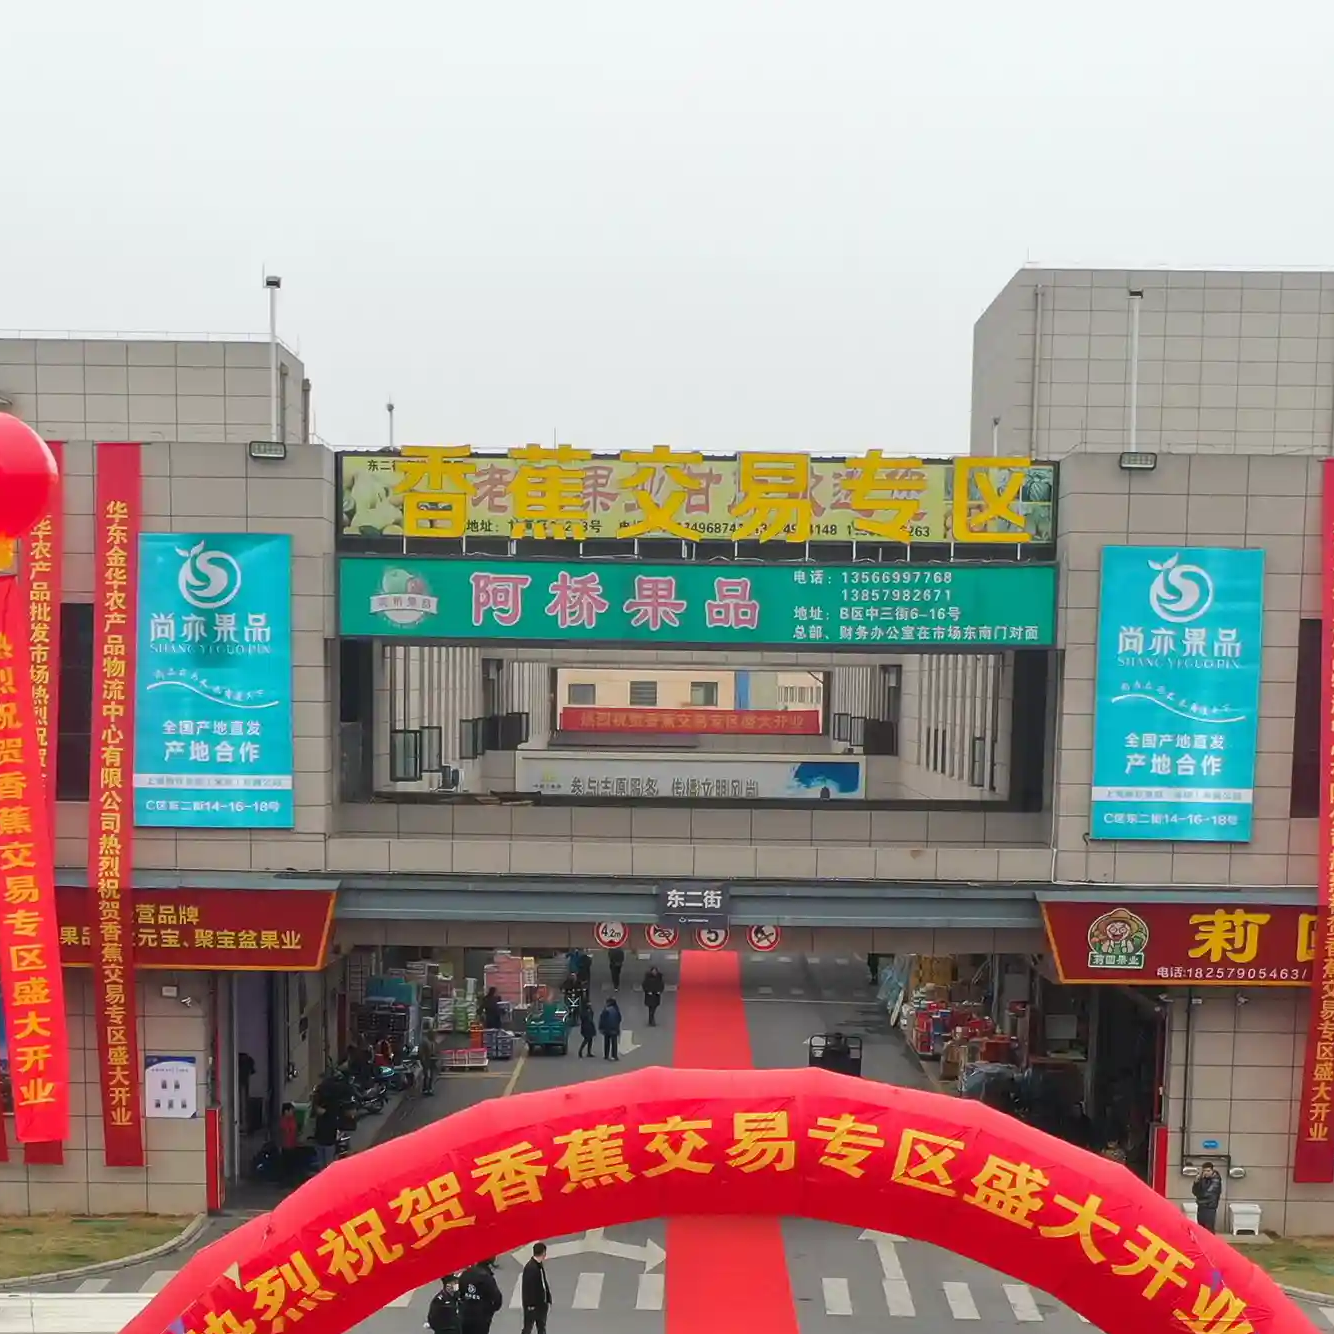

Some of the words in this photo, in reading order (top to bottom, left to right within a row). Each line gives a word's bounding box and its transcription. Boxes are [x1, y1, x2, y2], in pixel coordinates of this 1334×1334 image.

[394, 444, 1031, 544] 香蕉交易专区
[470, 571, 760, 631] 阿桥果品
[840, 588, 953, 602] 13857982671
[149, 611, 272, 643] 尚亦果品
[1117, 625, 1243, 658] 尚亦果品
[163, 719, 263, 737] 全国产地直发
[163, 740, 262, 764] 产地合作
[1124, 732, 1226, 750] 全国产地直发
[1124, 753, 1224, 776] 产地合作
[666, 888, 723, 910] 东二街
